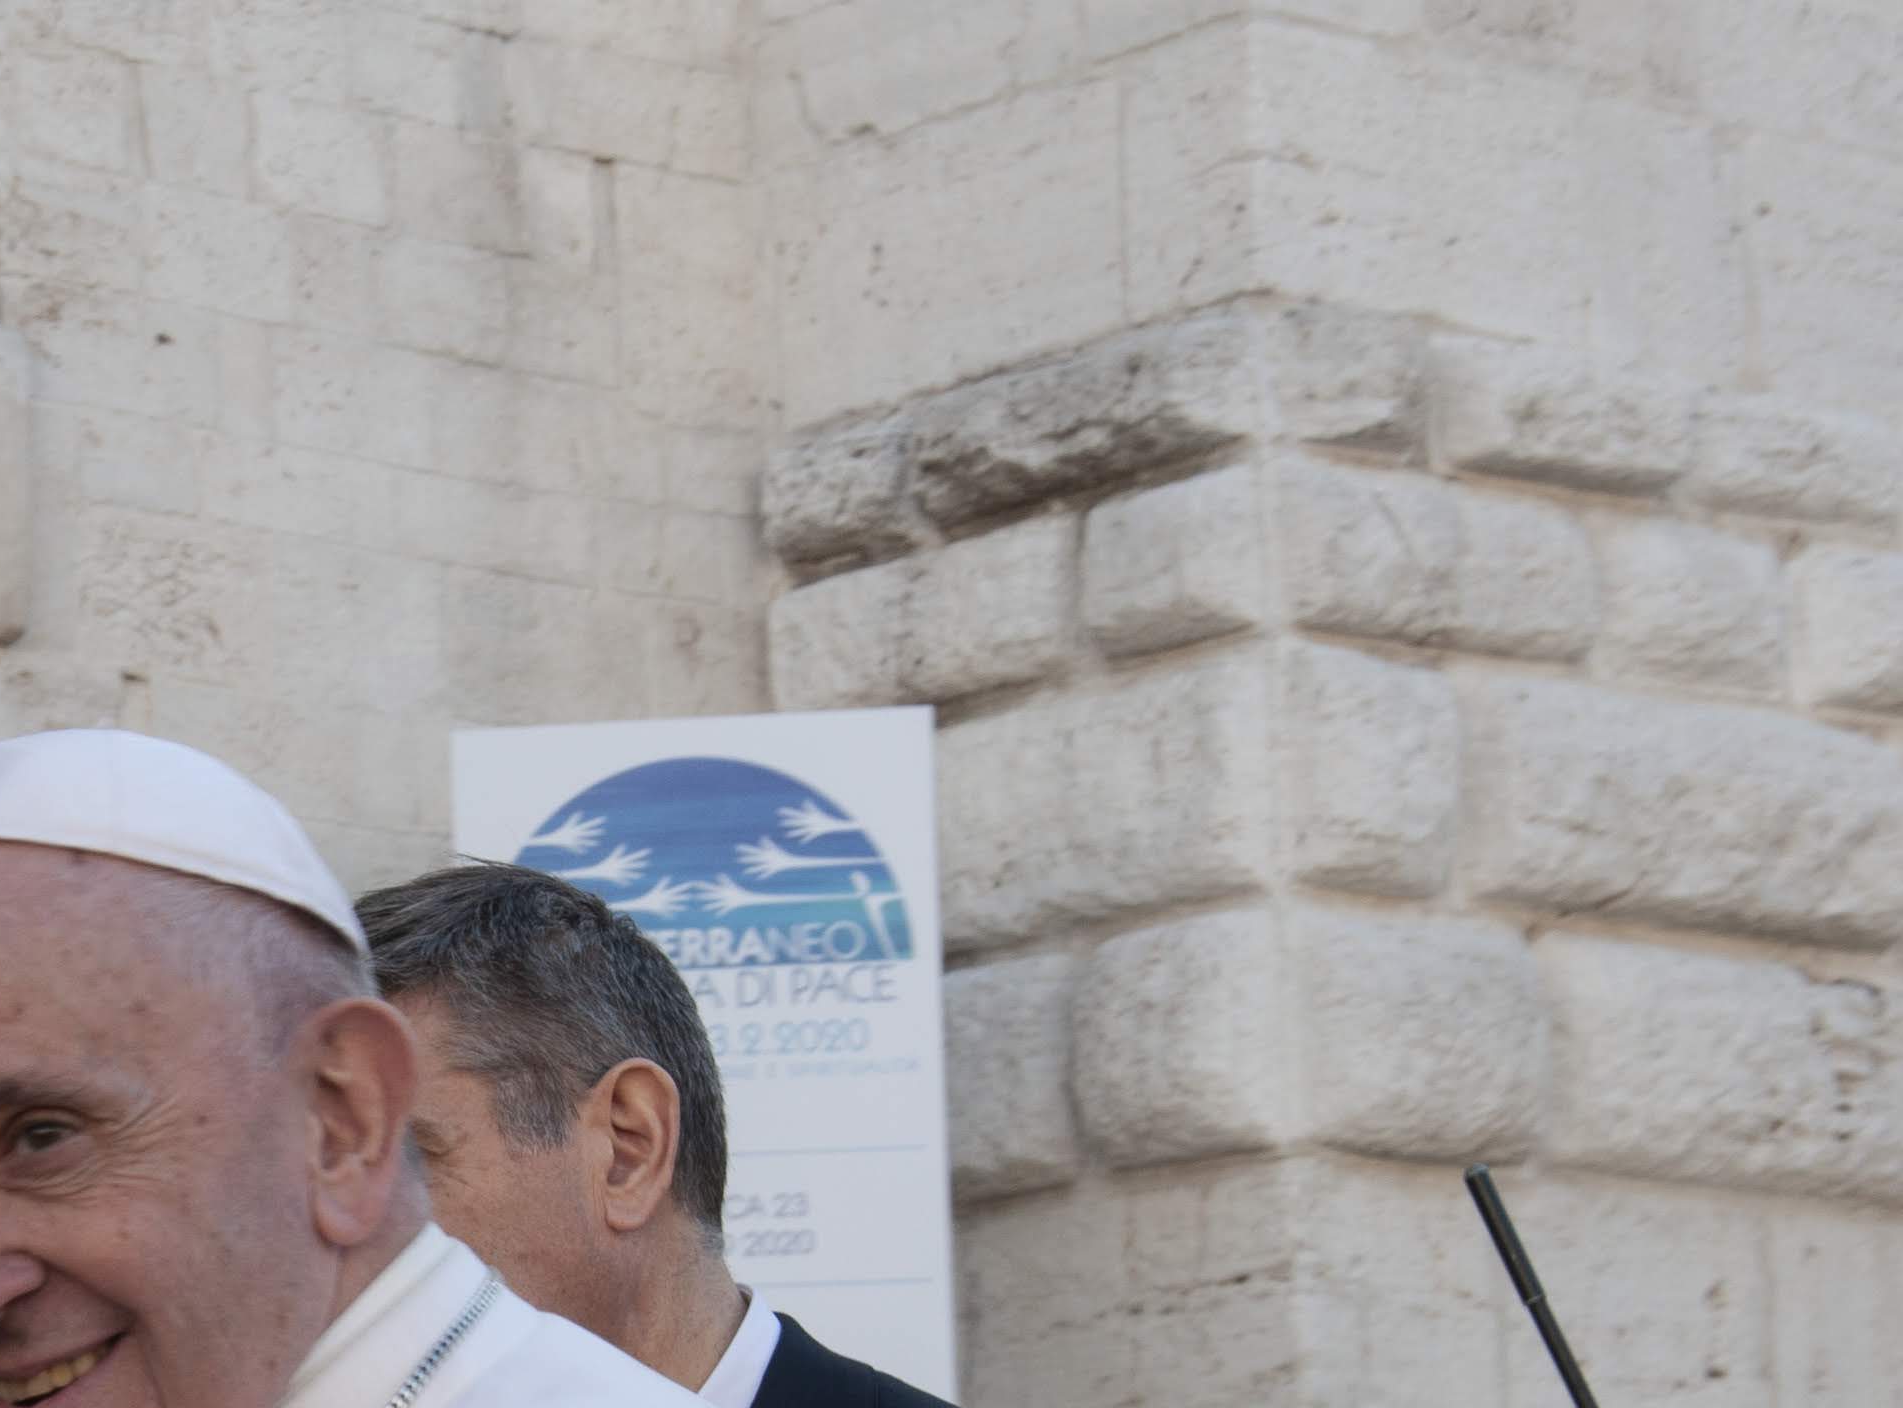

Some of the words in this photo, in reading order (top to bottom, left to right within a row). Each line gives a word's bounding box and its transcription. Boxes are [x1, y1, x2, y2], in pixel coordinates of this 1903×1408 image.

[648, 920, 866, 966] ERRANEO
[695, 973, 725, 1007] A
[735, 969, 775, 1007] DI
[790, 964, 898, 1003] PACE
[709, 1017, 869, 1055] 3.2.2020
[742, 1229, 816, 1257] 2020
